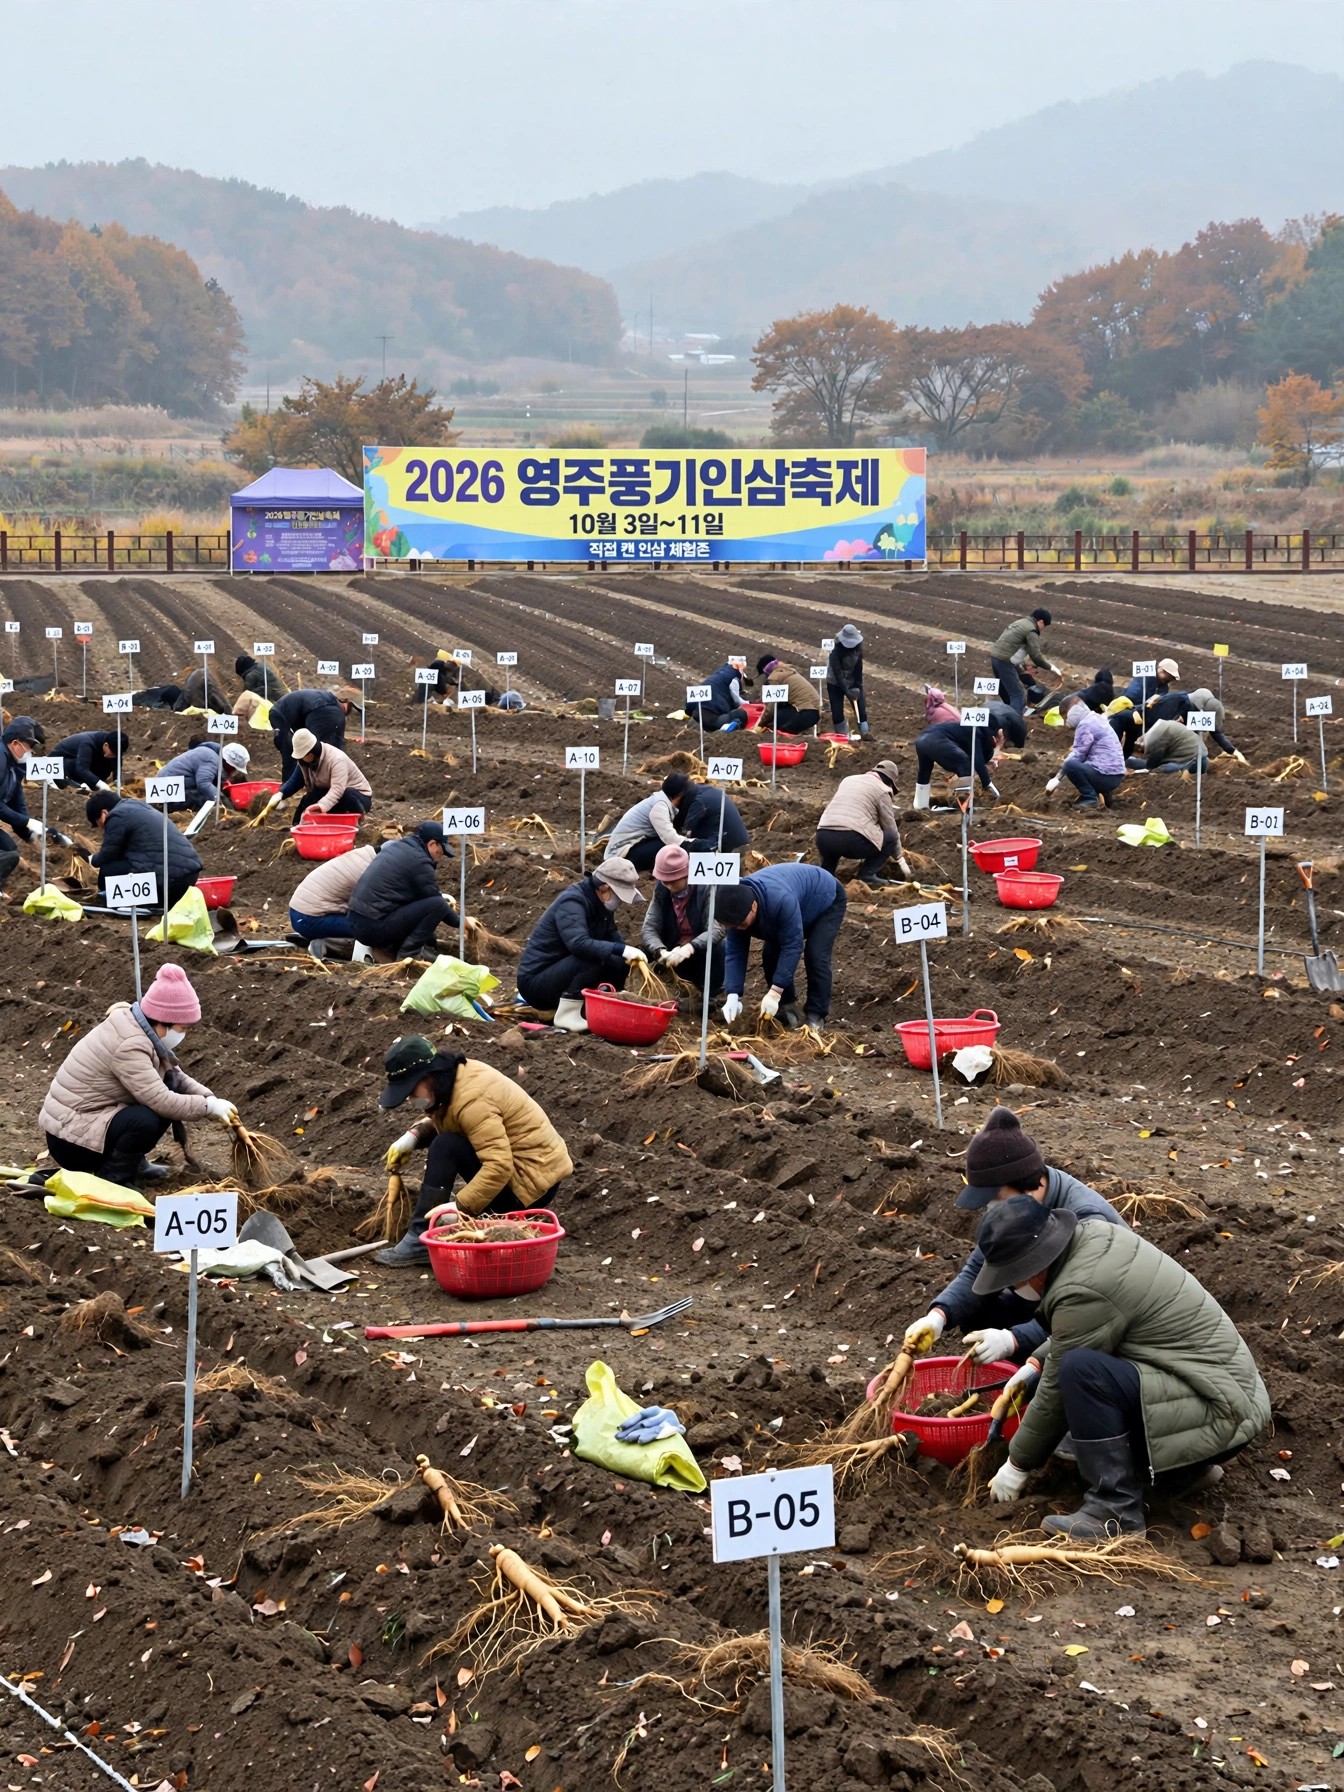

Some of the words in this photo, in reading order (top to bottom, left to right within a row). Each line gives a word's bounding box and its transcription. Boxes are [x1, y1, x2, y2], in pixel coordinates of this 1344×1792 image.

[405, 459, 504, 503] 2026
[517, 457, 880, 507] 영주풍기인삼축제
[569, 512, 617, 535] 10월
[623, 512, 724, 535] 3일~11일
[589, 542, 617, 558] 직접
[620, 542, 635, 558] 캔
[639, 542, 667, 558] 인삼
[669, 542, 711, 558] 체험존
[618, 682, 638, 693] A-07
[765, 688, 786, 699] A-07
[964, 712, 985, 722] A-09
[1190, 716, 1212, 727] A-06
[211, 719, 235, 730] A-04
[570, 753, 595, 763] A-10
[31, 763, 59, 775] A-05
[712, 763, 738, 775] A-07
[150, 784, 179, 797] A-07
[448, 815, 480, 828] A-06
[694, 862, 734, 877] A-07
[112, 881, 151, 899] A-06
[901, 912, 941, 934] B-04
[164, 1208, 227, 1236] A-05
[727, 1490, 820, 1538] B-05
